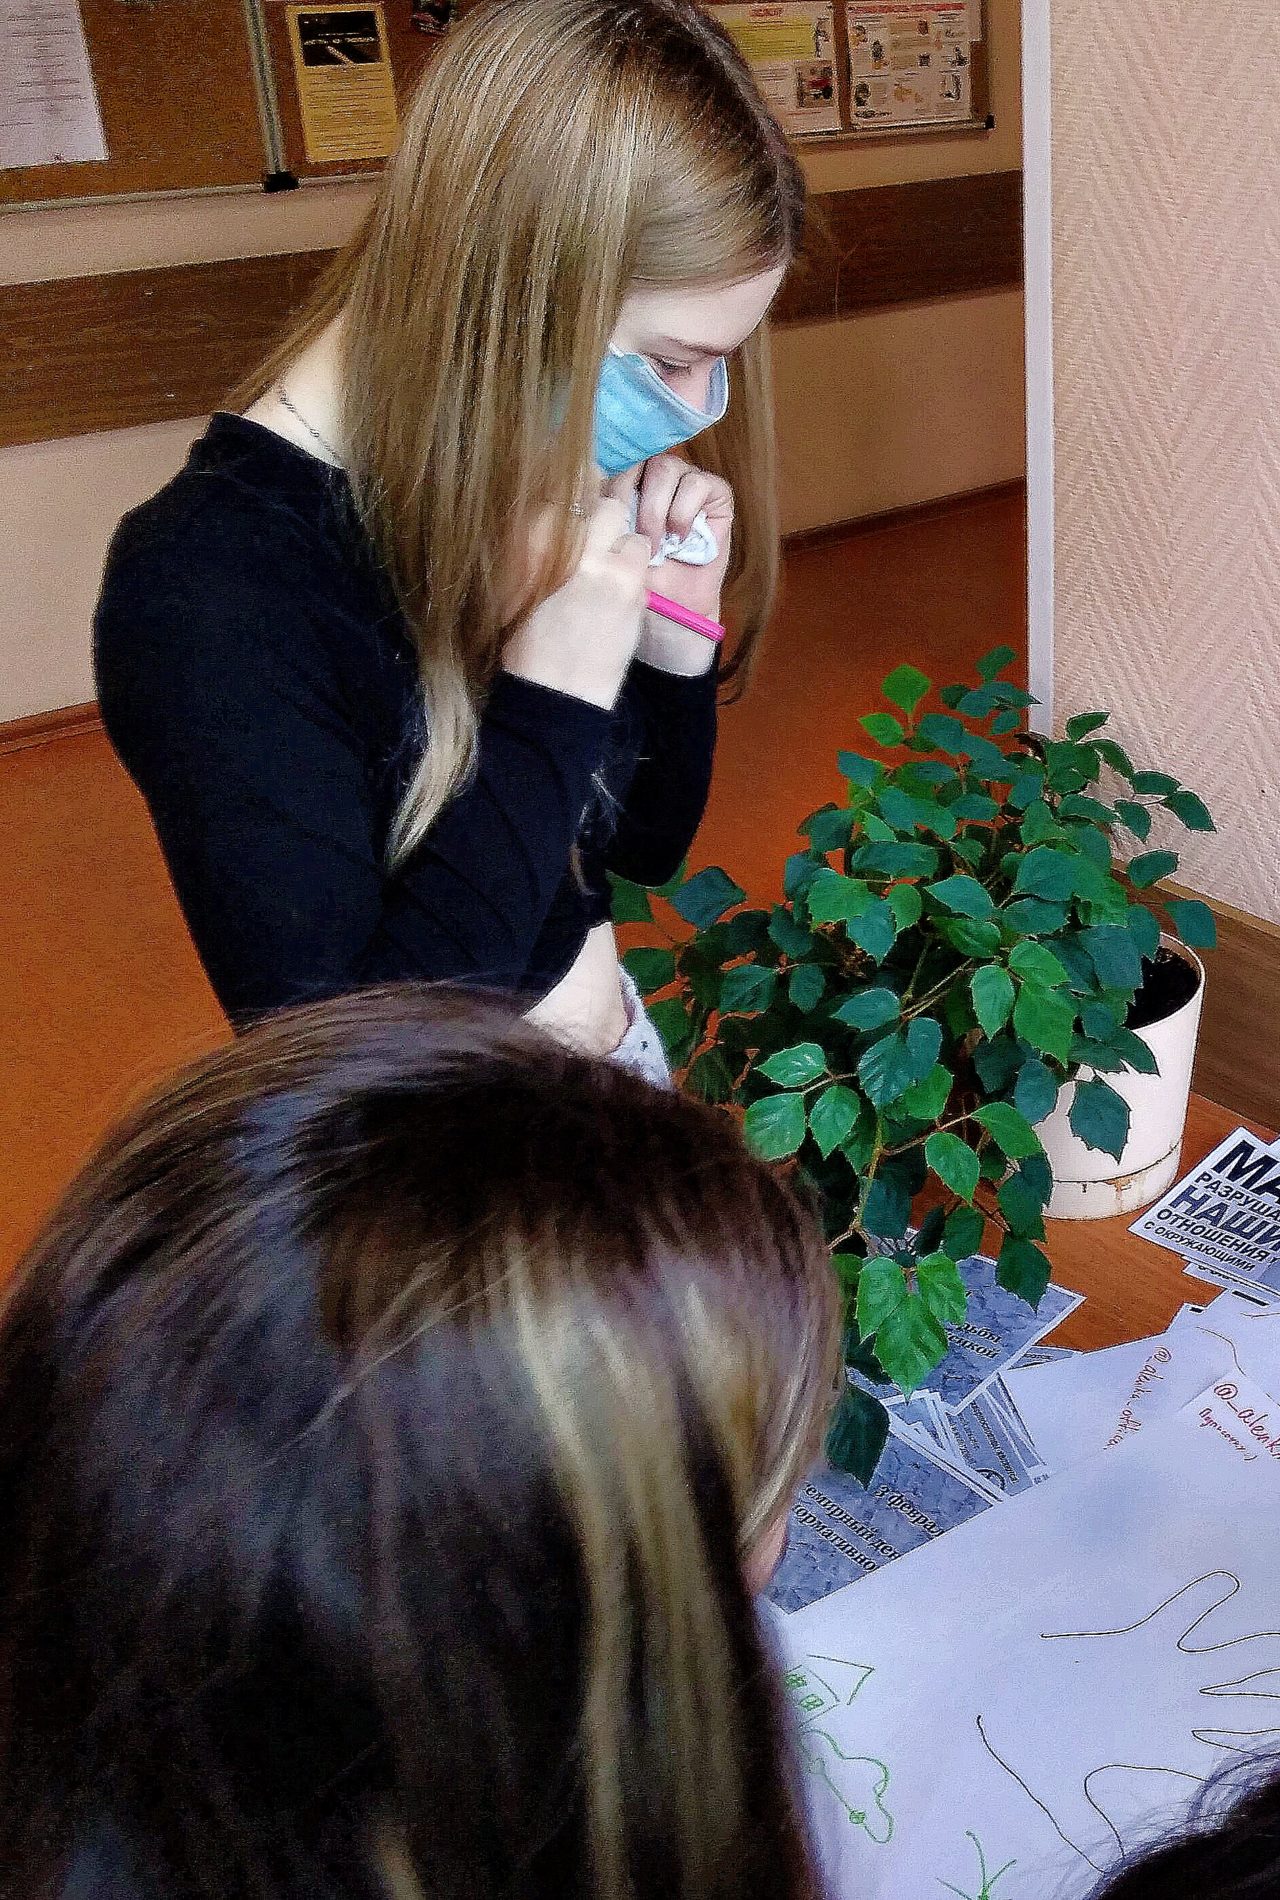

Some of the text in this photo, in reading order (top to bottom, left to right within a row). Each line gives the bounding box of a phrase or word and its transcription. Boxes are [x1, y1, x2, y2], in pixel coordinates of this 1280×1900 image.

[1144, 1221, 1256, 1271] С ОКРУЖАЮЩИМИ
[1157, 1208, 1269, 1262] ОТНОШЕНИЯ
[792, 1503, 880, 1572] ормативно
[803, 1482, 879, 1543] емирный
[875, 1484, 946, 1538] 3 феврал
